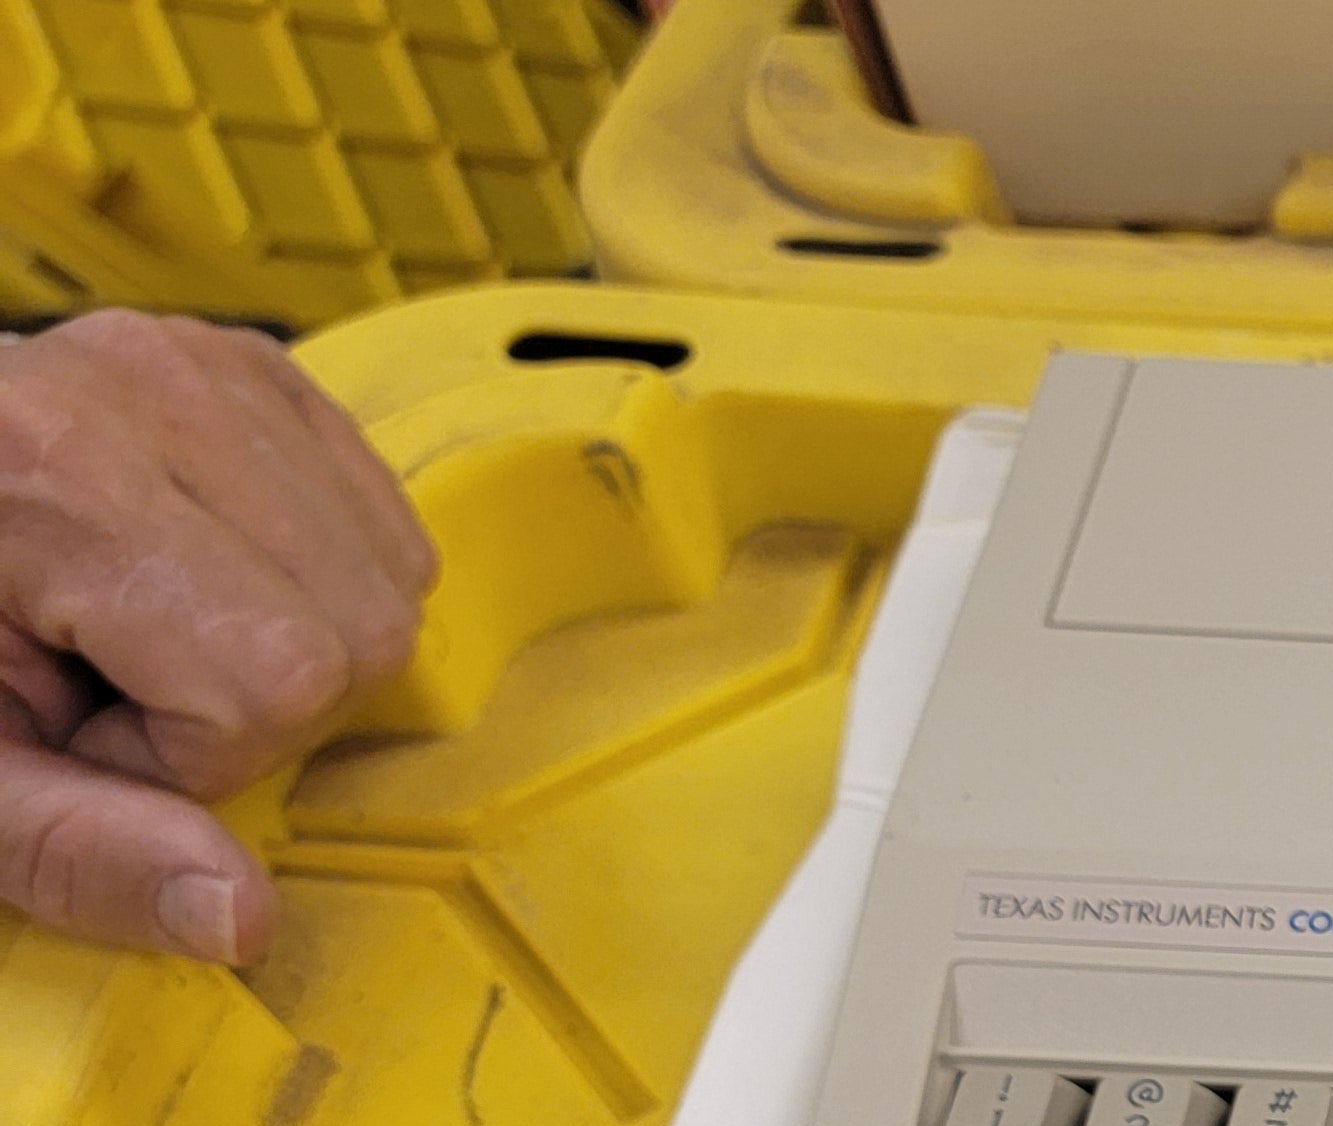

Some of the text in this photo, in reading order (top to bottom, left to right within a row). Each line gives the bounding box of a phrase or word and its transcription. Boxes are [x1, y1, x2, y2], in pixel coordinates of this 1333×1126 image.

[979, 892, 1065, 921] TEXAS
[1072, 898, 1277, 931] INSTRUMENTS
[997, 1073, 1013, 1103] !
[1125, 1078, 1164, 1109] @
[1268, 1088, 1298, 1114] #
